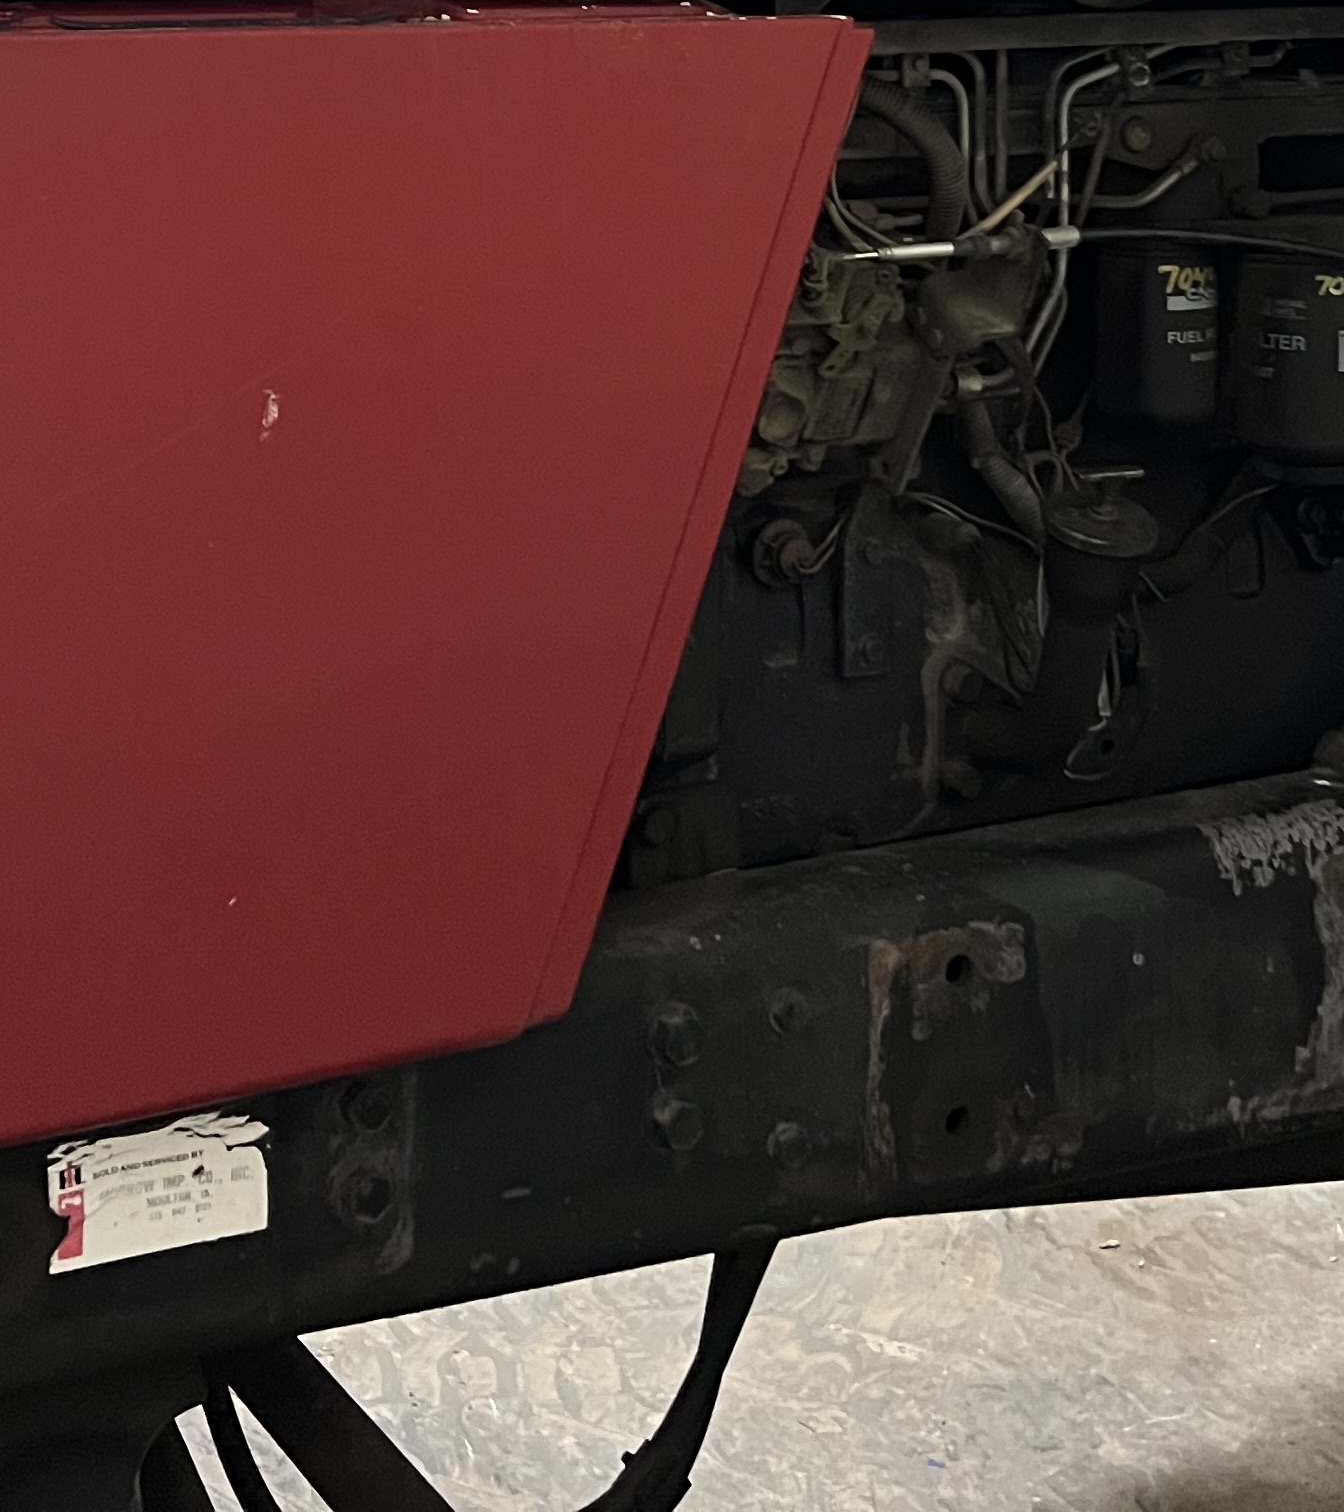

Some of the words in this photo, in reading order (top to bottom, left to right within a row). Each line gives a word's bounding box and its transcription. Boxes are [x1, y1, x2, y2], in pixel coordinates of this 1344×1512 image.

[1167, 330, 1205, 344] FUEL
[121, 1162, 141, 1171] AND
[142, 1153, 190, 1167] SERVICED
[191, 1149, 205, 1159] BY
